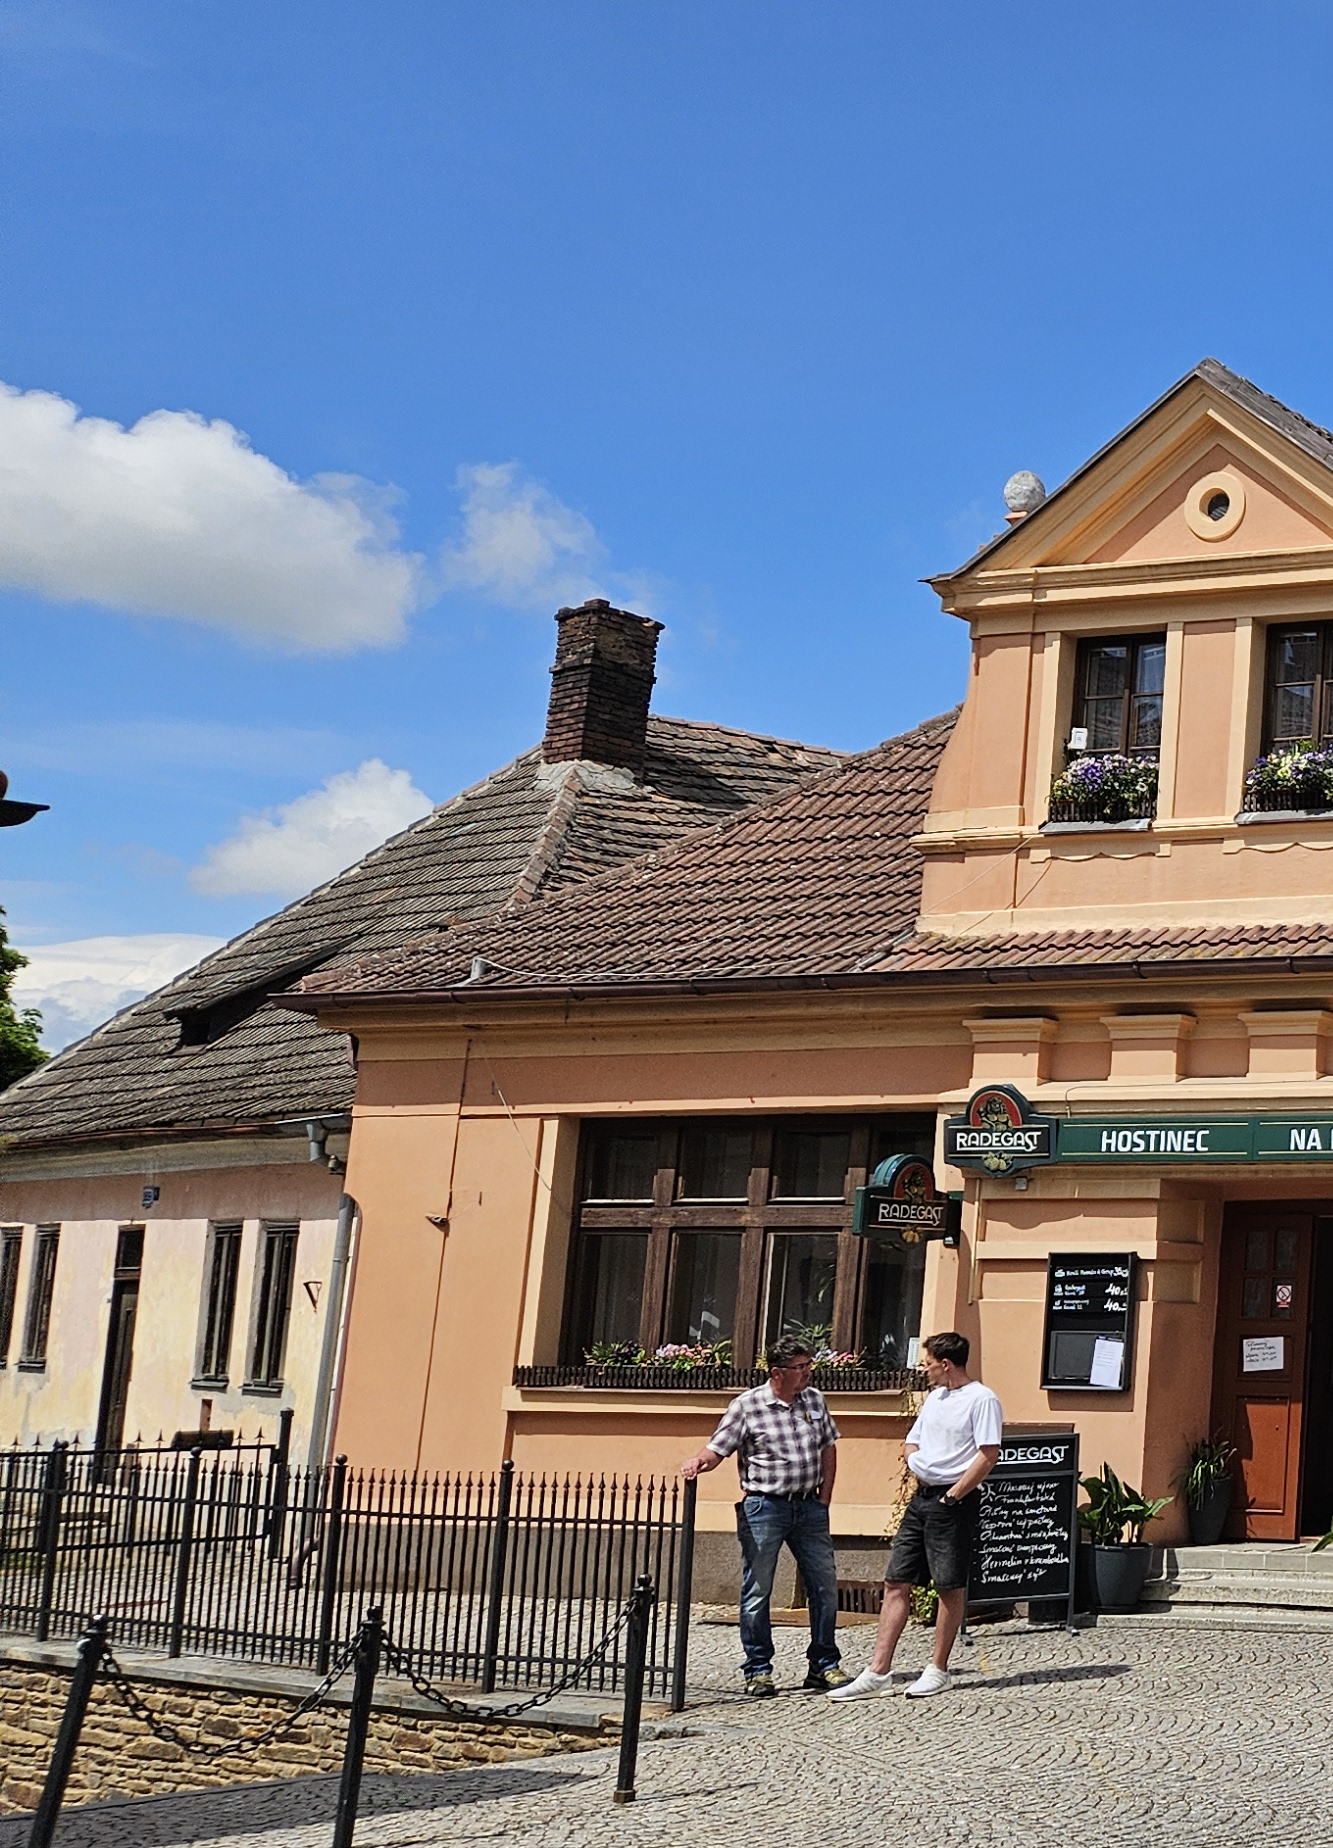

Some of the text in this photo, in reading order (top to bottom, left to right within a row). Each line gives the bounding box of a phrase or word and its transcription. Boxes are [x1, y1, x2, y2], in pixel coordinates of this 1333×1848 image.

[956, 1131, 1042, 1152] RADEGAST
[1101, 1130, 1209, 1152] HOSTINEC
[1289, 1128, 1322, 1150] NA
[878, 1203, 944, 1226] RADEGAST
[997, 1445, 1069, 1465] ADEGAST
